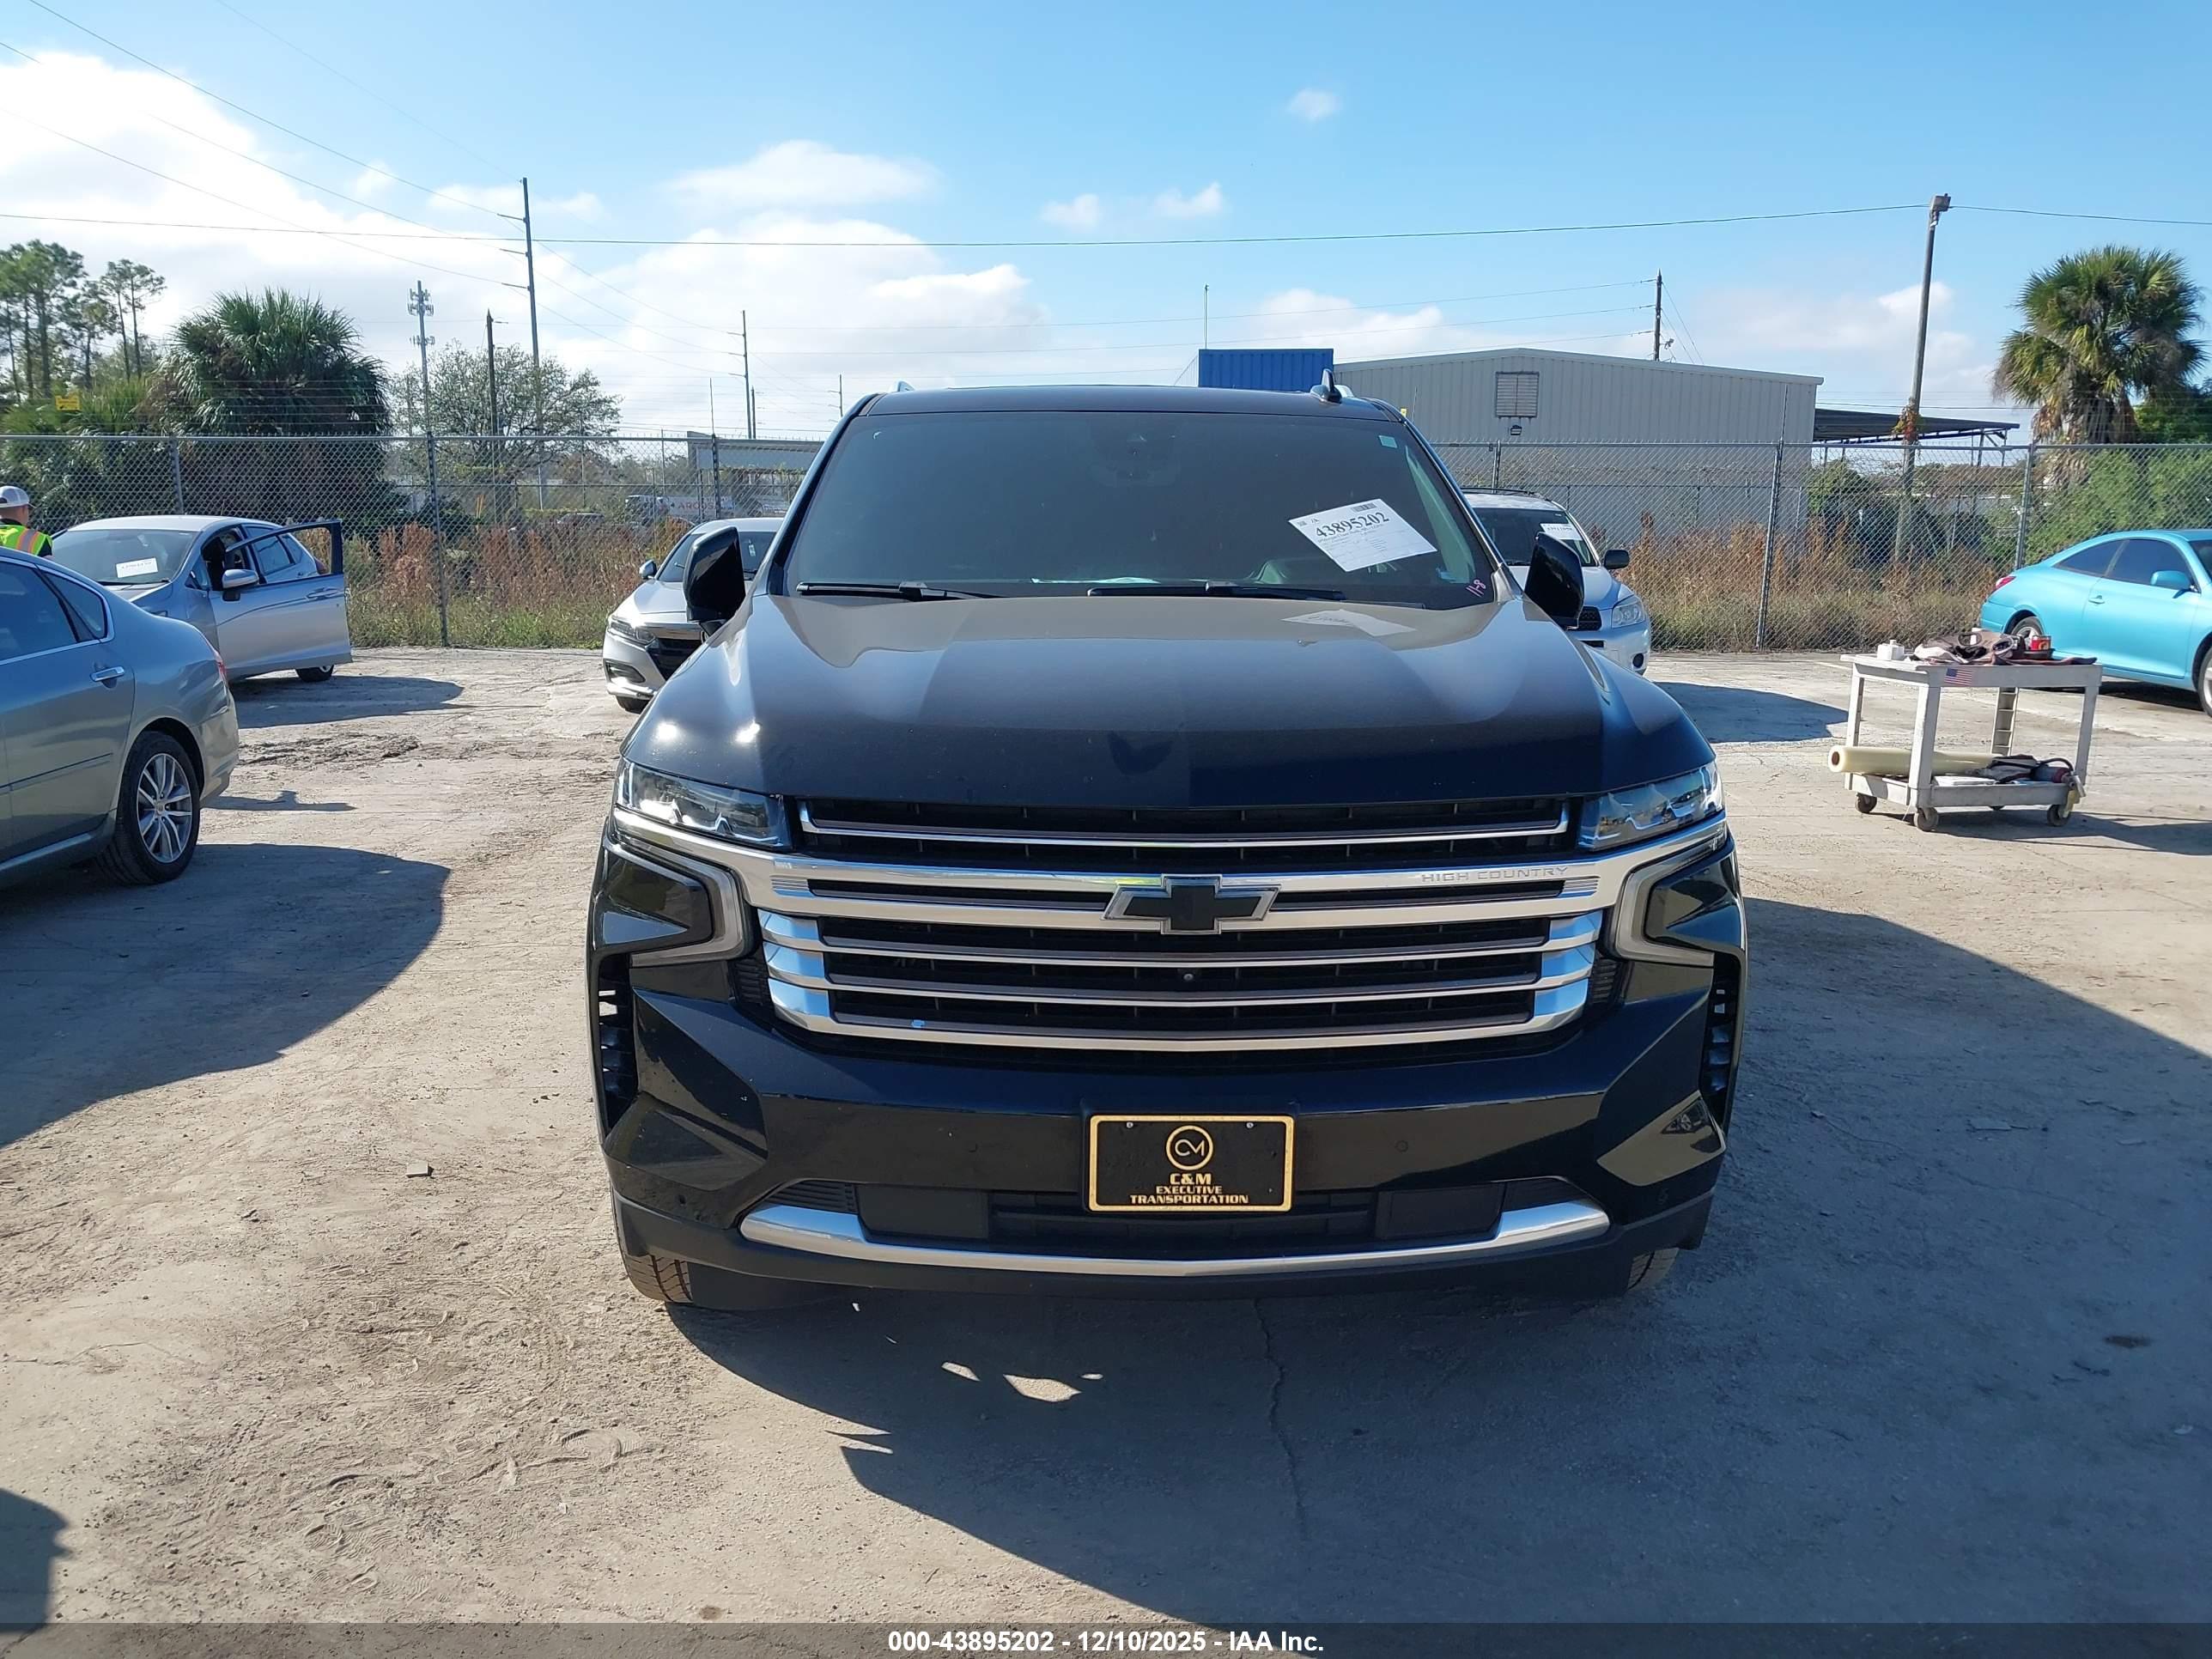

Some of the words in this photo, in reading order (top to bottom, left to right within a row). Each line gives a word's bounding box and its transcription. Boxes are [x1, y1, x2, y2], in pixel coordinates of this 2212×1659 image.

[1316, 512, 1390, 538] 43895202
[1421, 872, 1468, 883] HIGH
[1478, 866, 1568, 880] COUNTRY
[1170, 1173, 1212, 1185] C&M
[1156, 1186, 1223, 1194] EXECUTIVE
[1129, 1194, 1249, 1204] TRANSPORTATION
